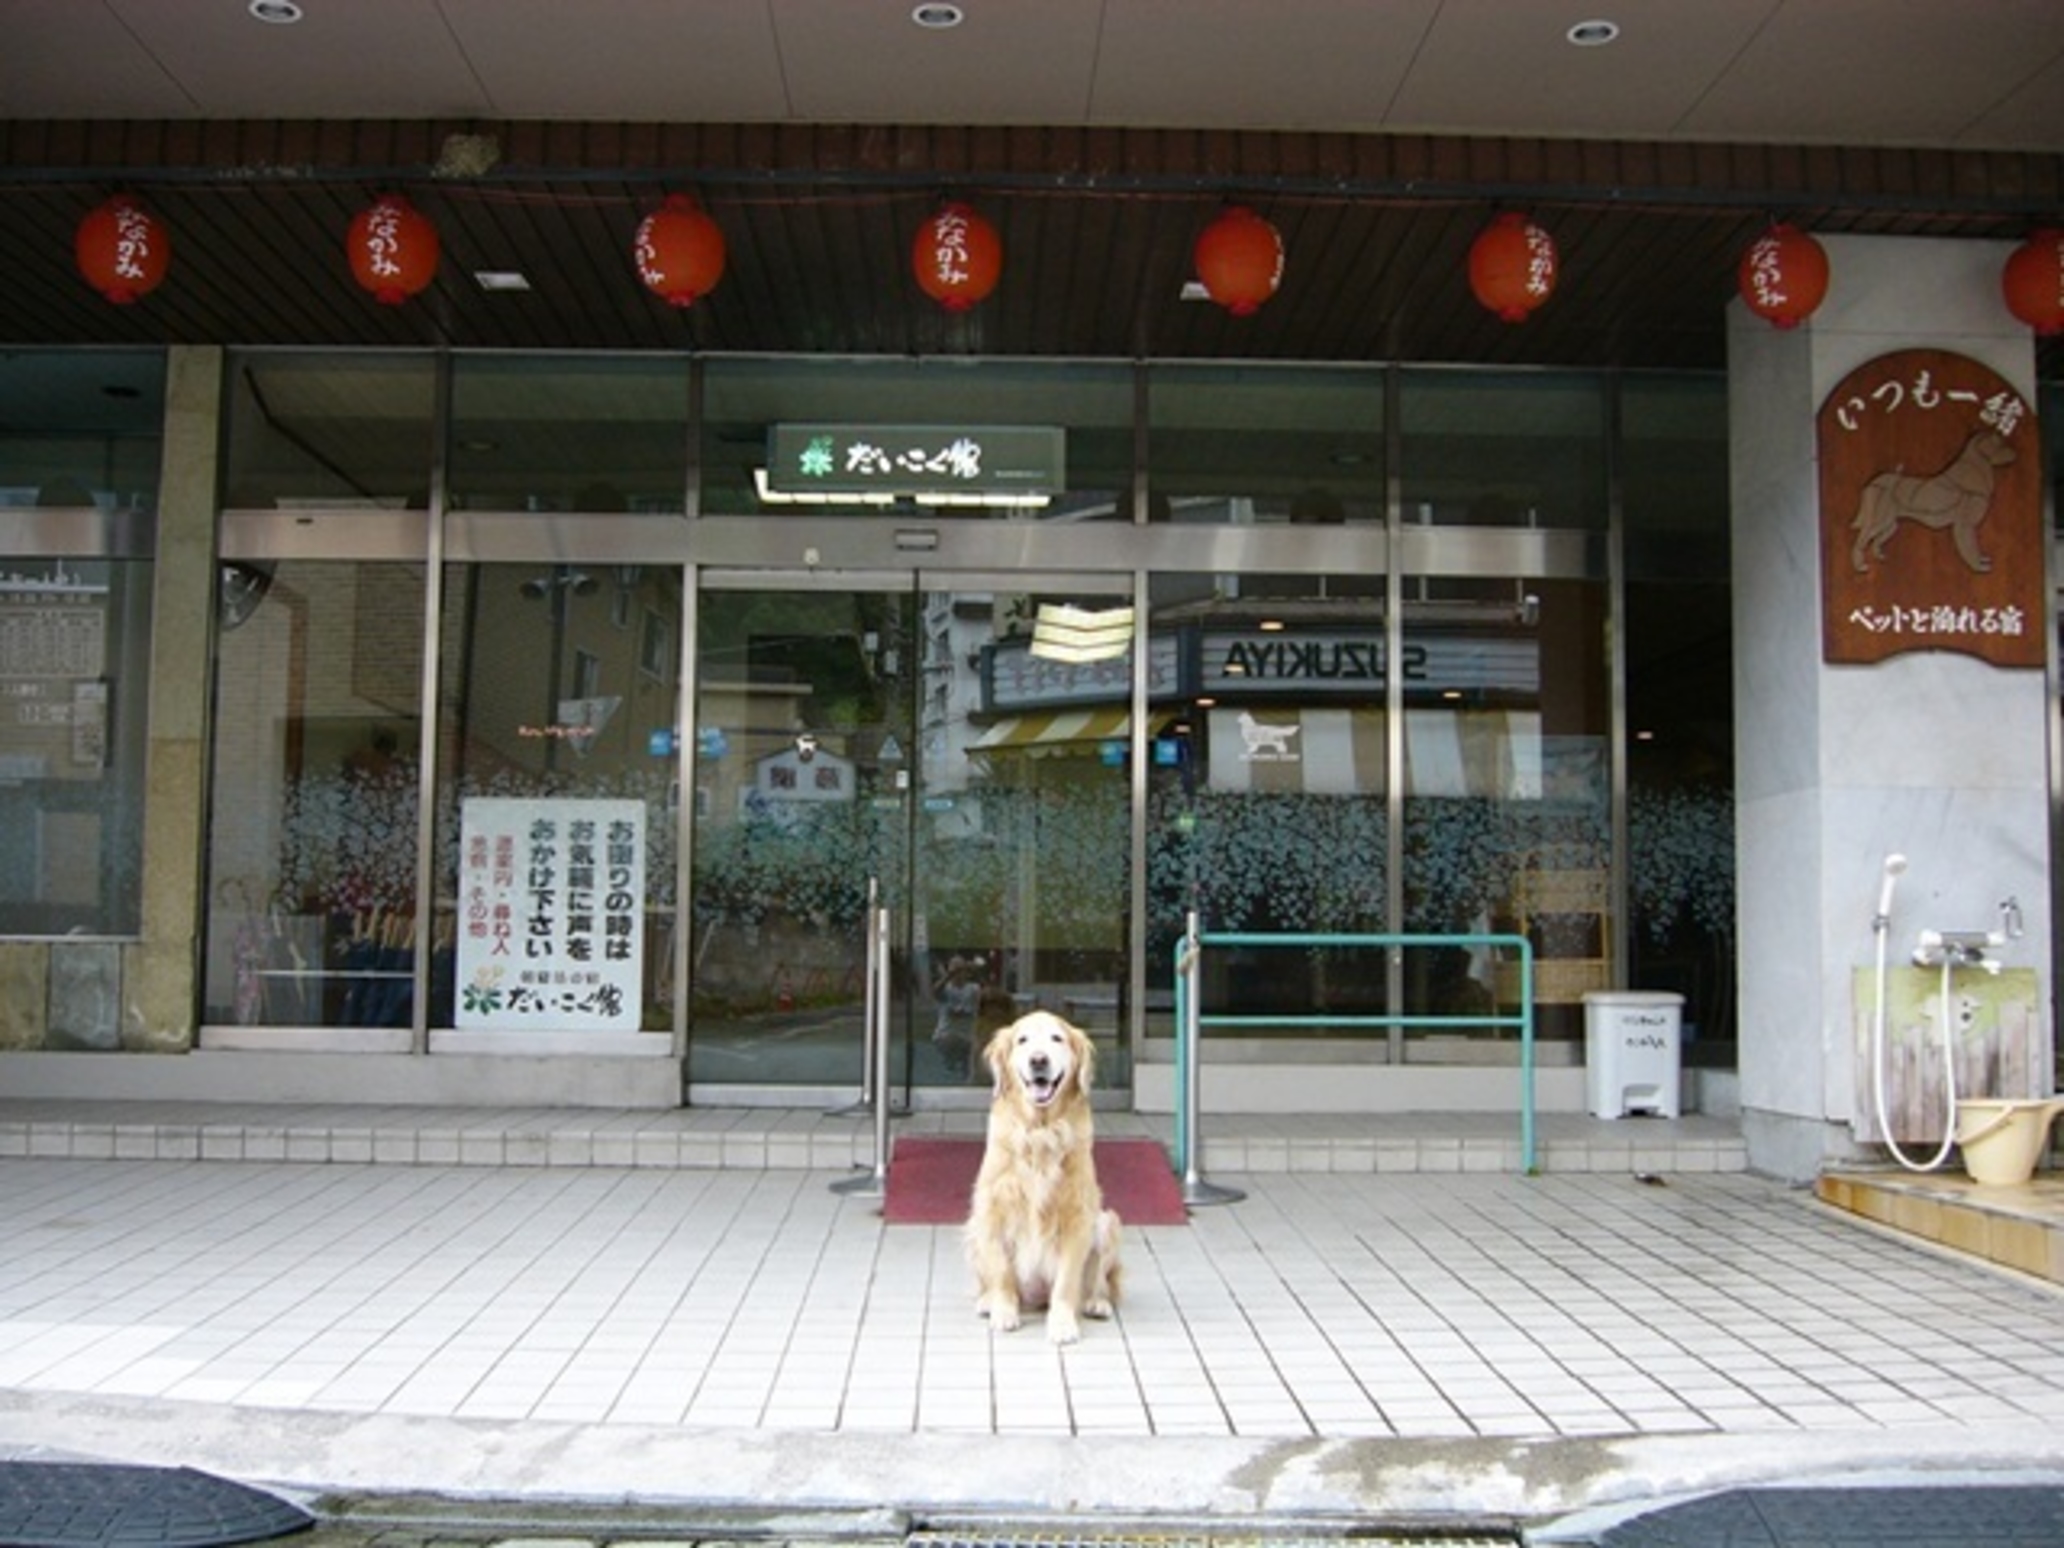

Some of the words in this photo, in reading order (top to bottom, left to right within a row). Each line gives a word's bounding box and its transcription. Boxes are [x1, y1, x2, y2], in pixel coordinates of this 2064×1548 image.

[1837, 371, 2023, 436] いつも一緒
[525, 818, 556, 959] おかけ下さい
